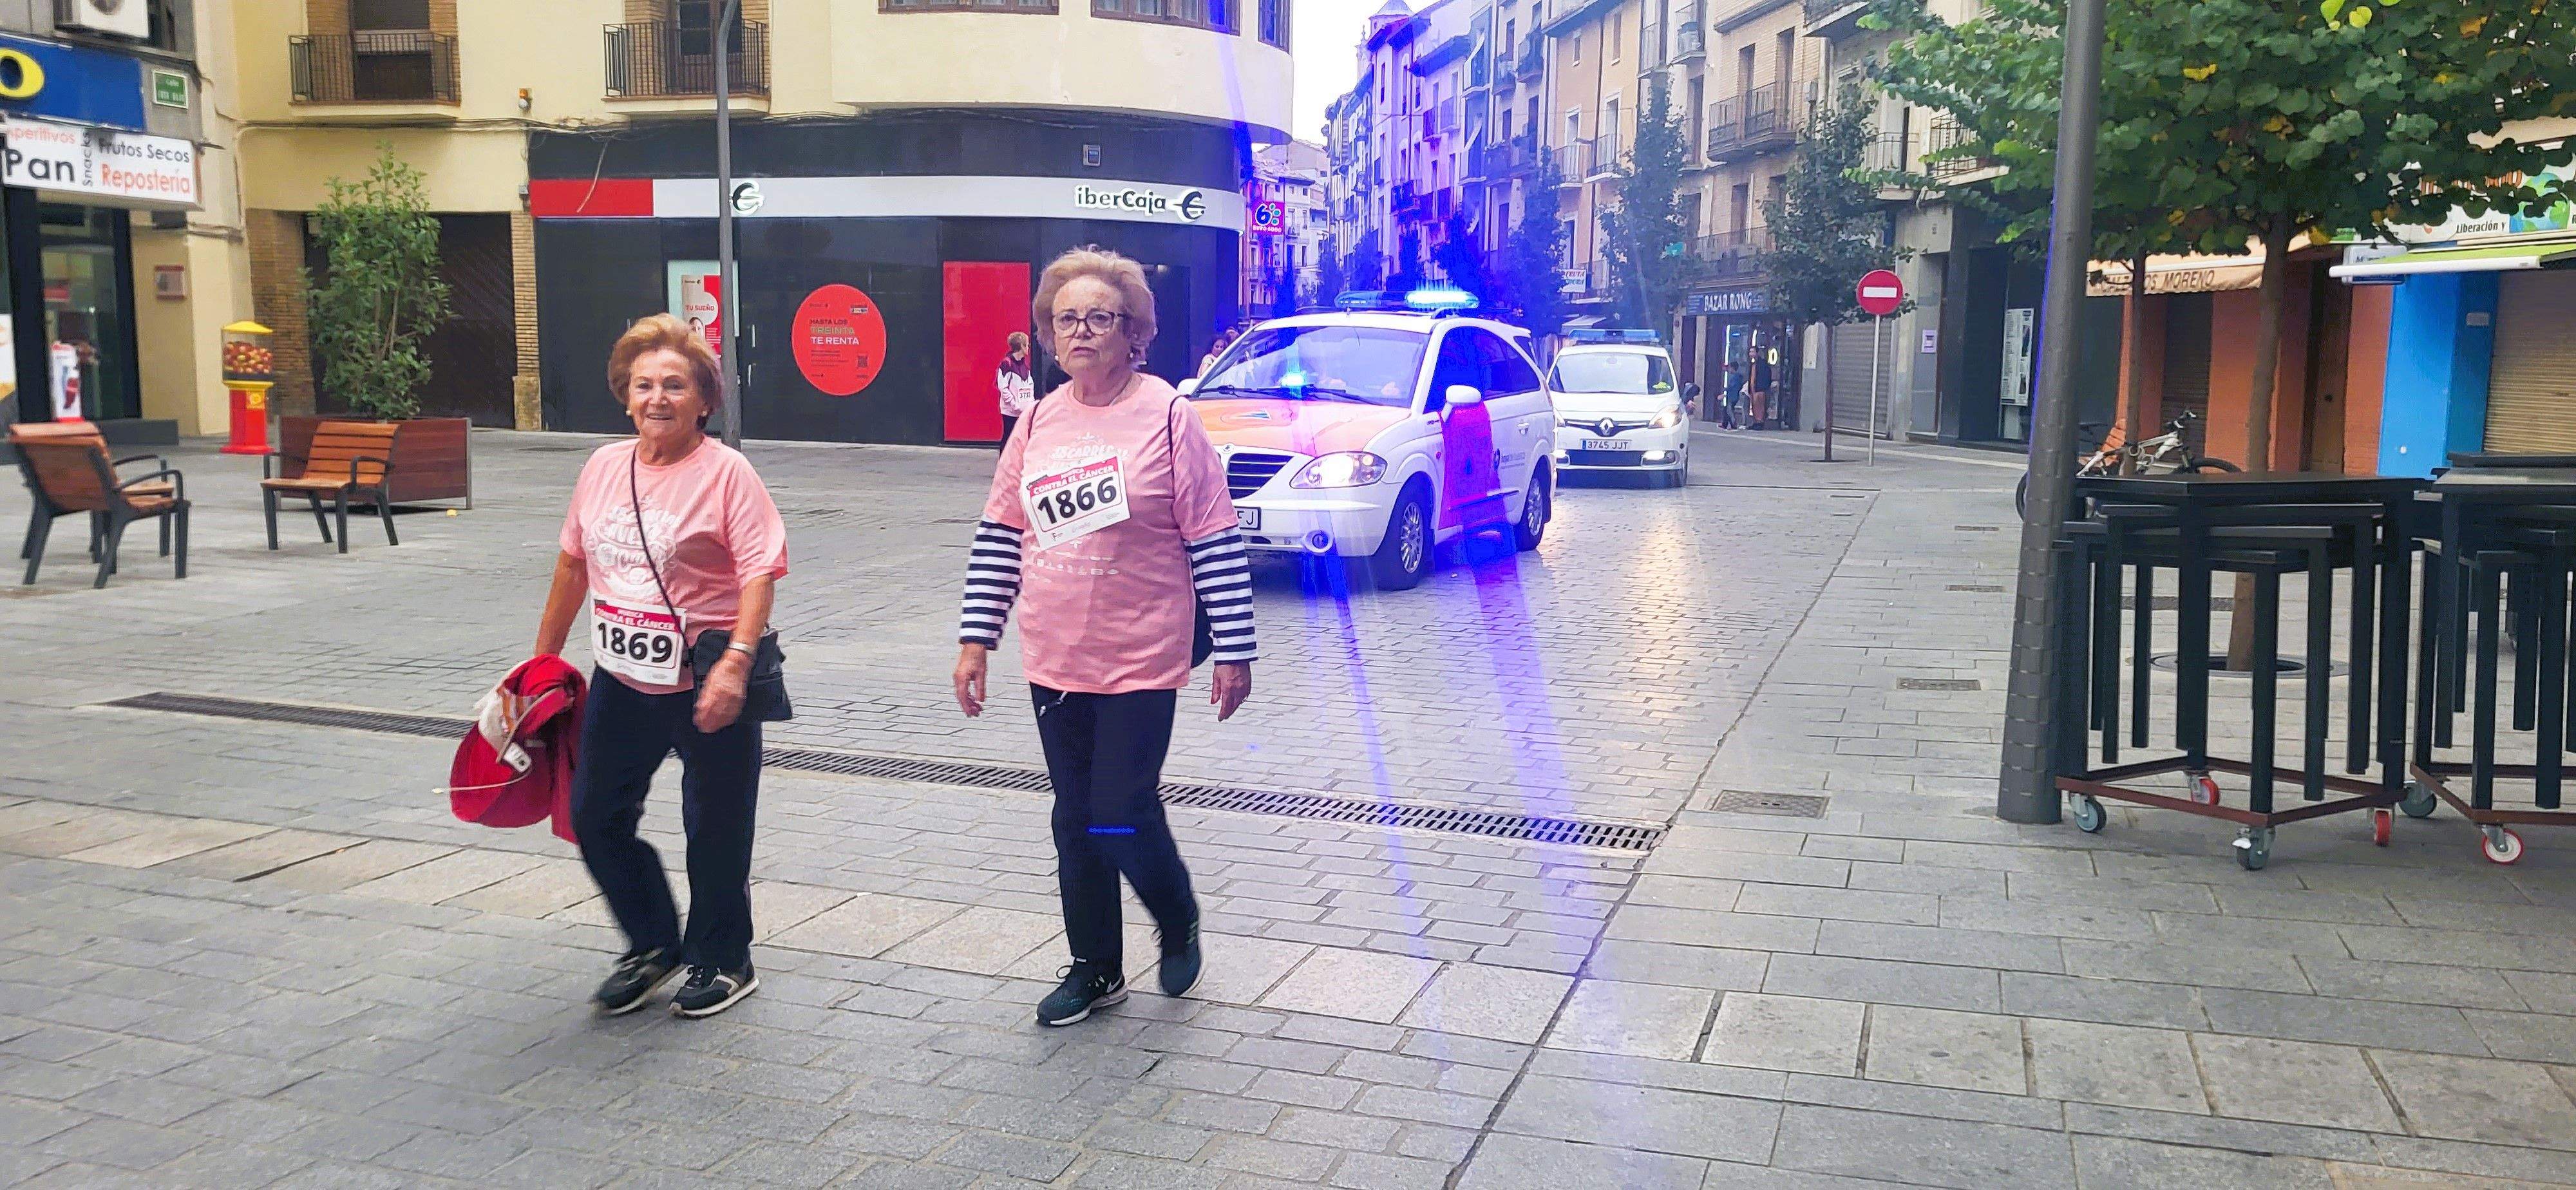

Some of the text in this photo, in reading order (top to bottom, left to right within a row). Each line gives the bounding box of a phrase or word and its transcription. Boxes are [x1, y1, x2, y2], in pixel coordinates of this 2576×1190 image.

[80, 131, 93, 187] Snacks
[99, 138, 189, 163] Frutos Secos
[6, 149, 75, 183] Pan
[102, 164, 191, 194] Repostería
[2456, 220, 2506, 234] Liberación y
[2163, 270, 2215, 290] MORENO
[1704, 294, 1727, 311] BAZAR
[826, 337, 860, 345] RENTA
[1033, 465, 1115, 495] CONTRA EL CÁNCER
[1037, 476, 1117, 524] 1866
[598, 622, 672, 663] 1869
